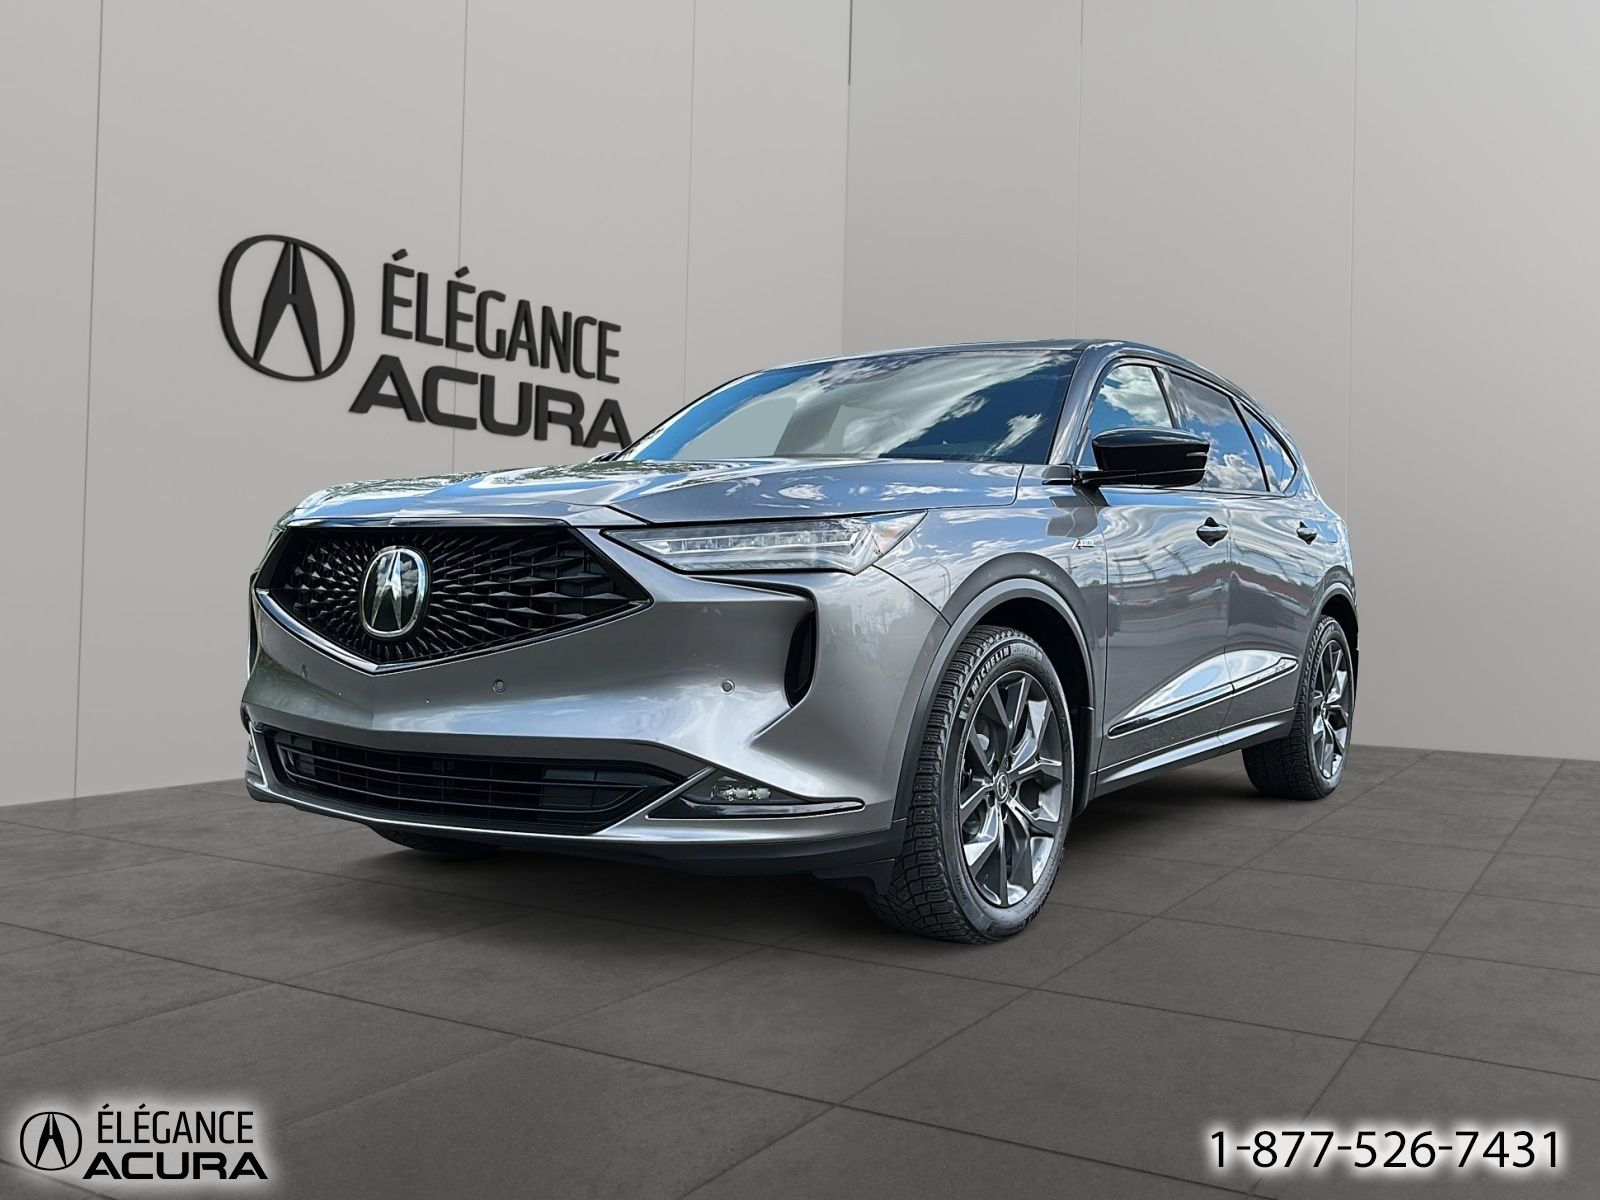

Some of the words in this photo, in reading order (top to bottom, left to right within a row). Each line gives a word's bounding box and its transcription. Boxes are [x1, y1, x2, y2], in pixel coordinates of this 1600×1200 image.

[381, 248, 622, 384] ÉLÉGANCE
[348, 354, 633, 450] ACURA
[970, 645, 1011, 696] MICHELIN
